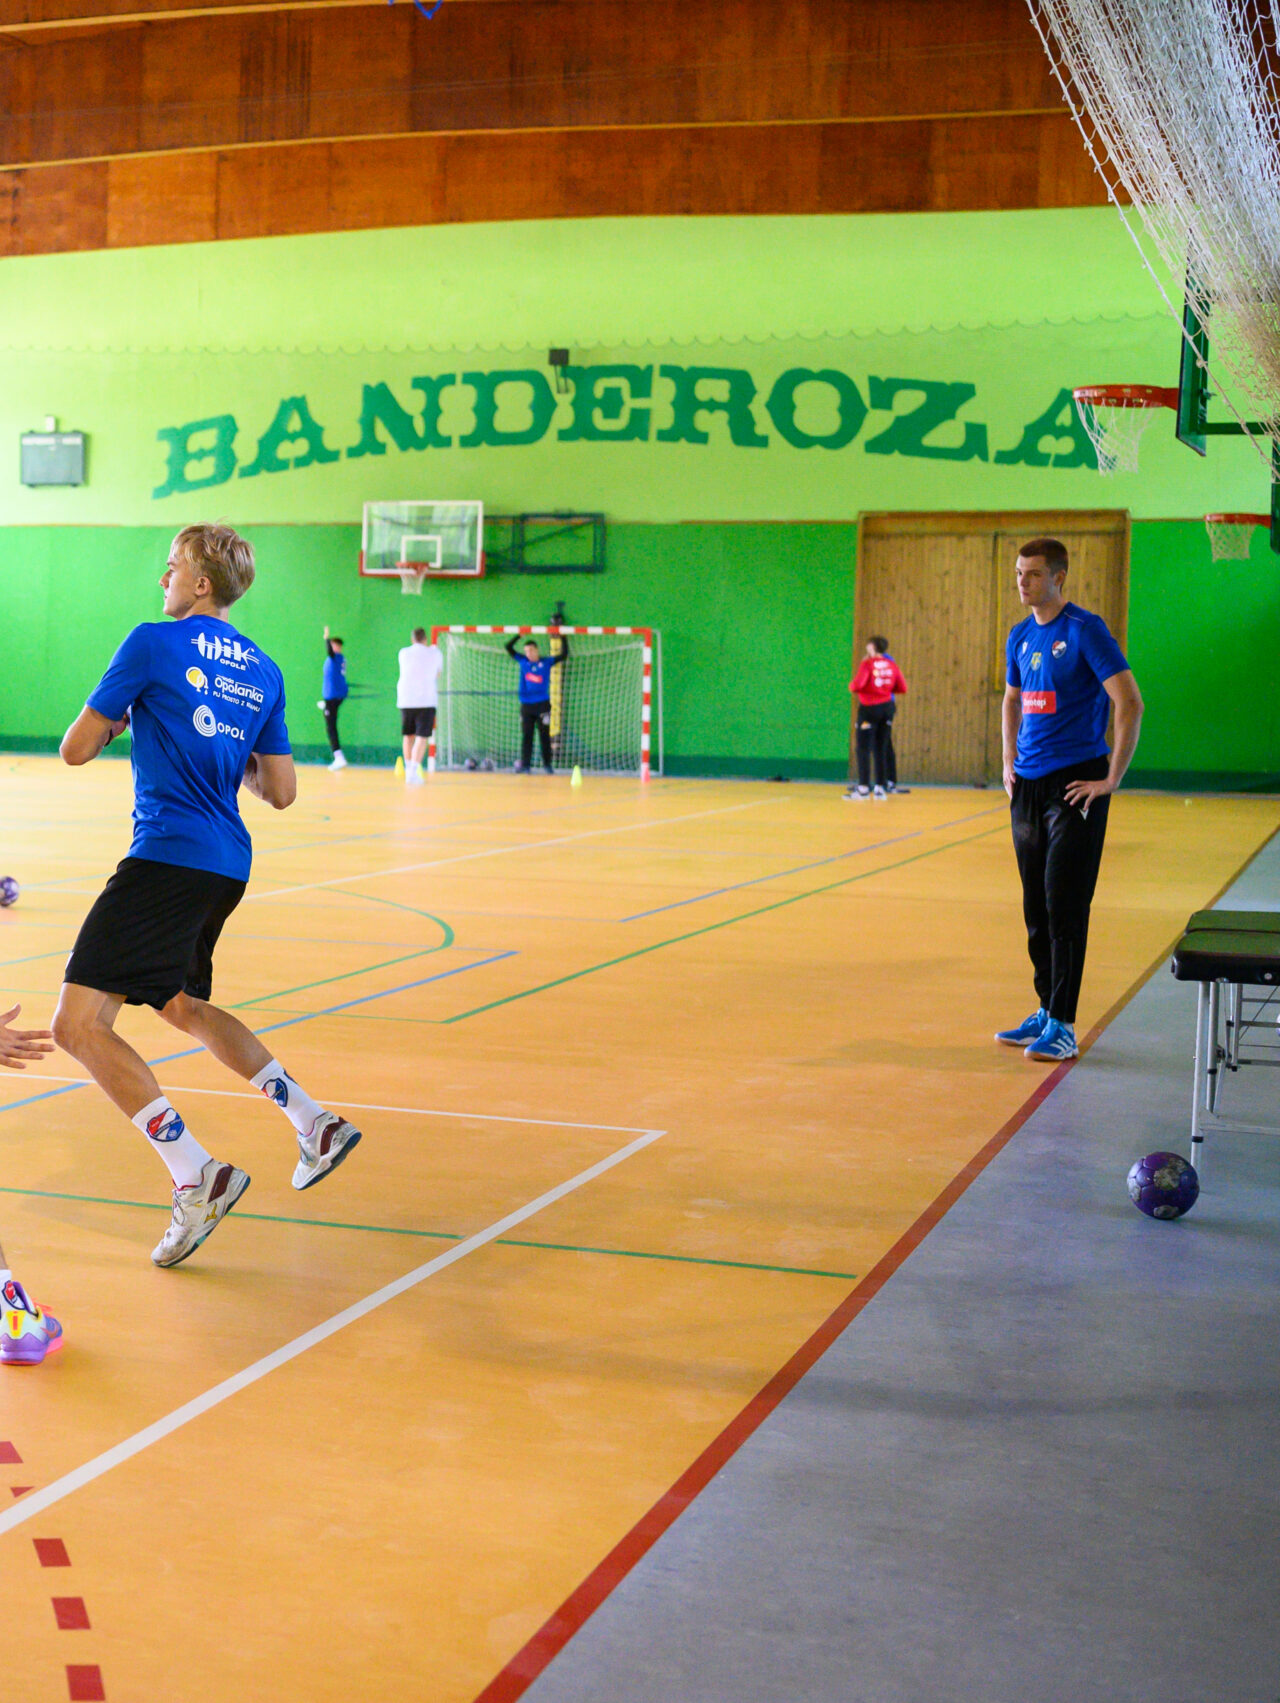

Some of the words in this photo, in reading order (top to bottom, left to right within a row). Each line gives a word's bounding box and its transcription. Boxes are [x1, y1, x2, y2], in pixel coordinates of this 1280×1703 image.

[152, 364, 1117, 500] BANDEROZA
[220, 658, 247, 671] OPOLE
[214, 676, 264, 703] Opolanka
